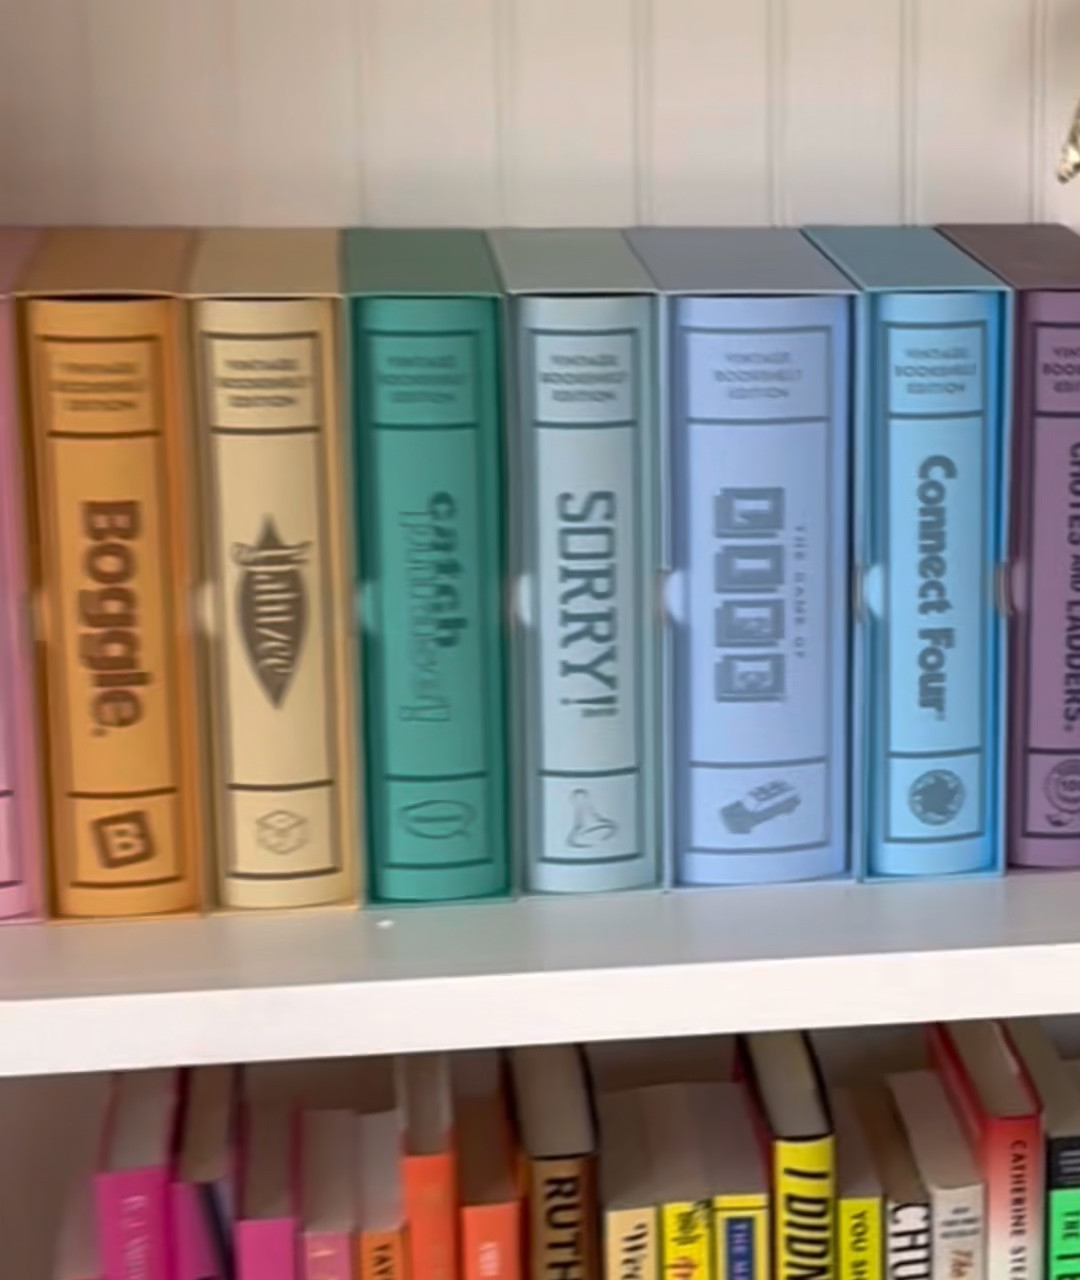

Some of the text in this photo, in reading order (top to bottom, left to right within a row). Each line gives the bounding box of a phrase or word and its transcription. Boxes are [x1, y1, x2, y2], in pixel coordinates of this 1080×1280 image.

[916, 455, 957, 713] Connect Four
[1008, 1139, 1029, 1238] CATHERINE
[732, 1221, 751, 1259] THE
[848, 1209, 869, 1254] YOU
[949, 1248, 972, 1280] The
